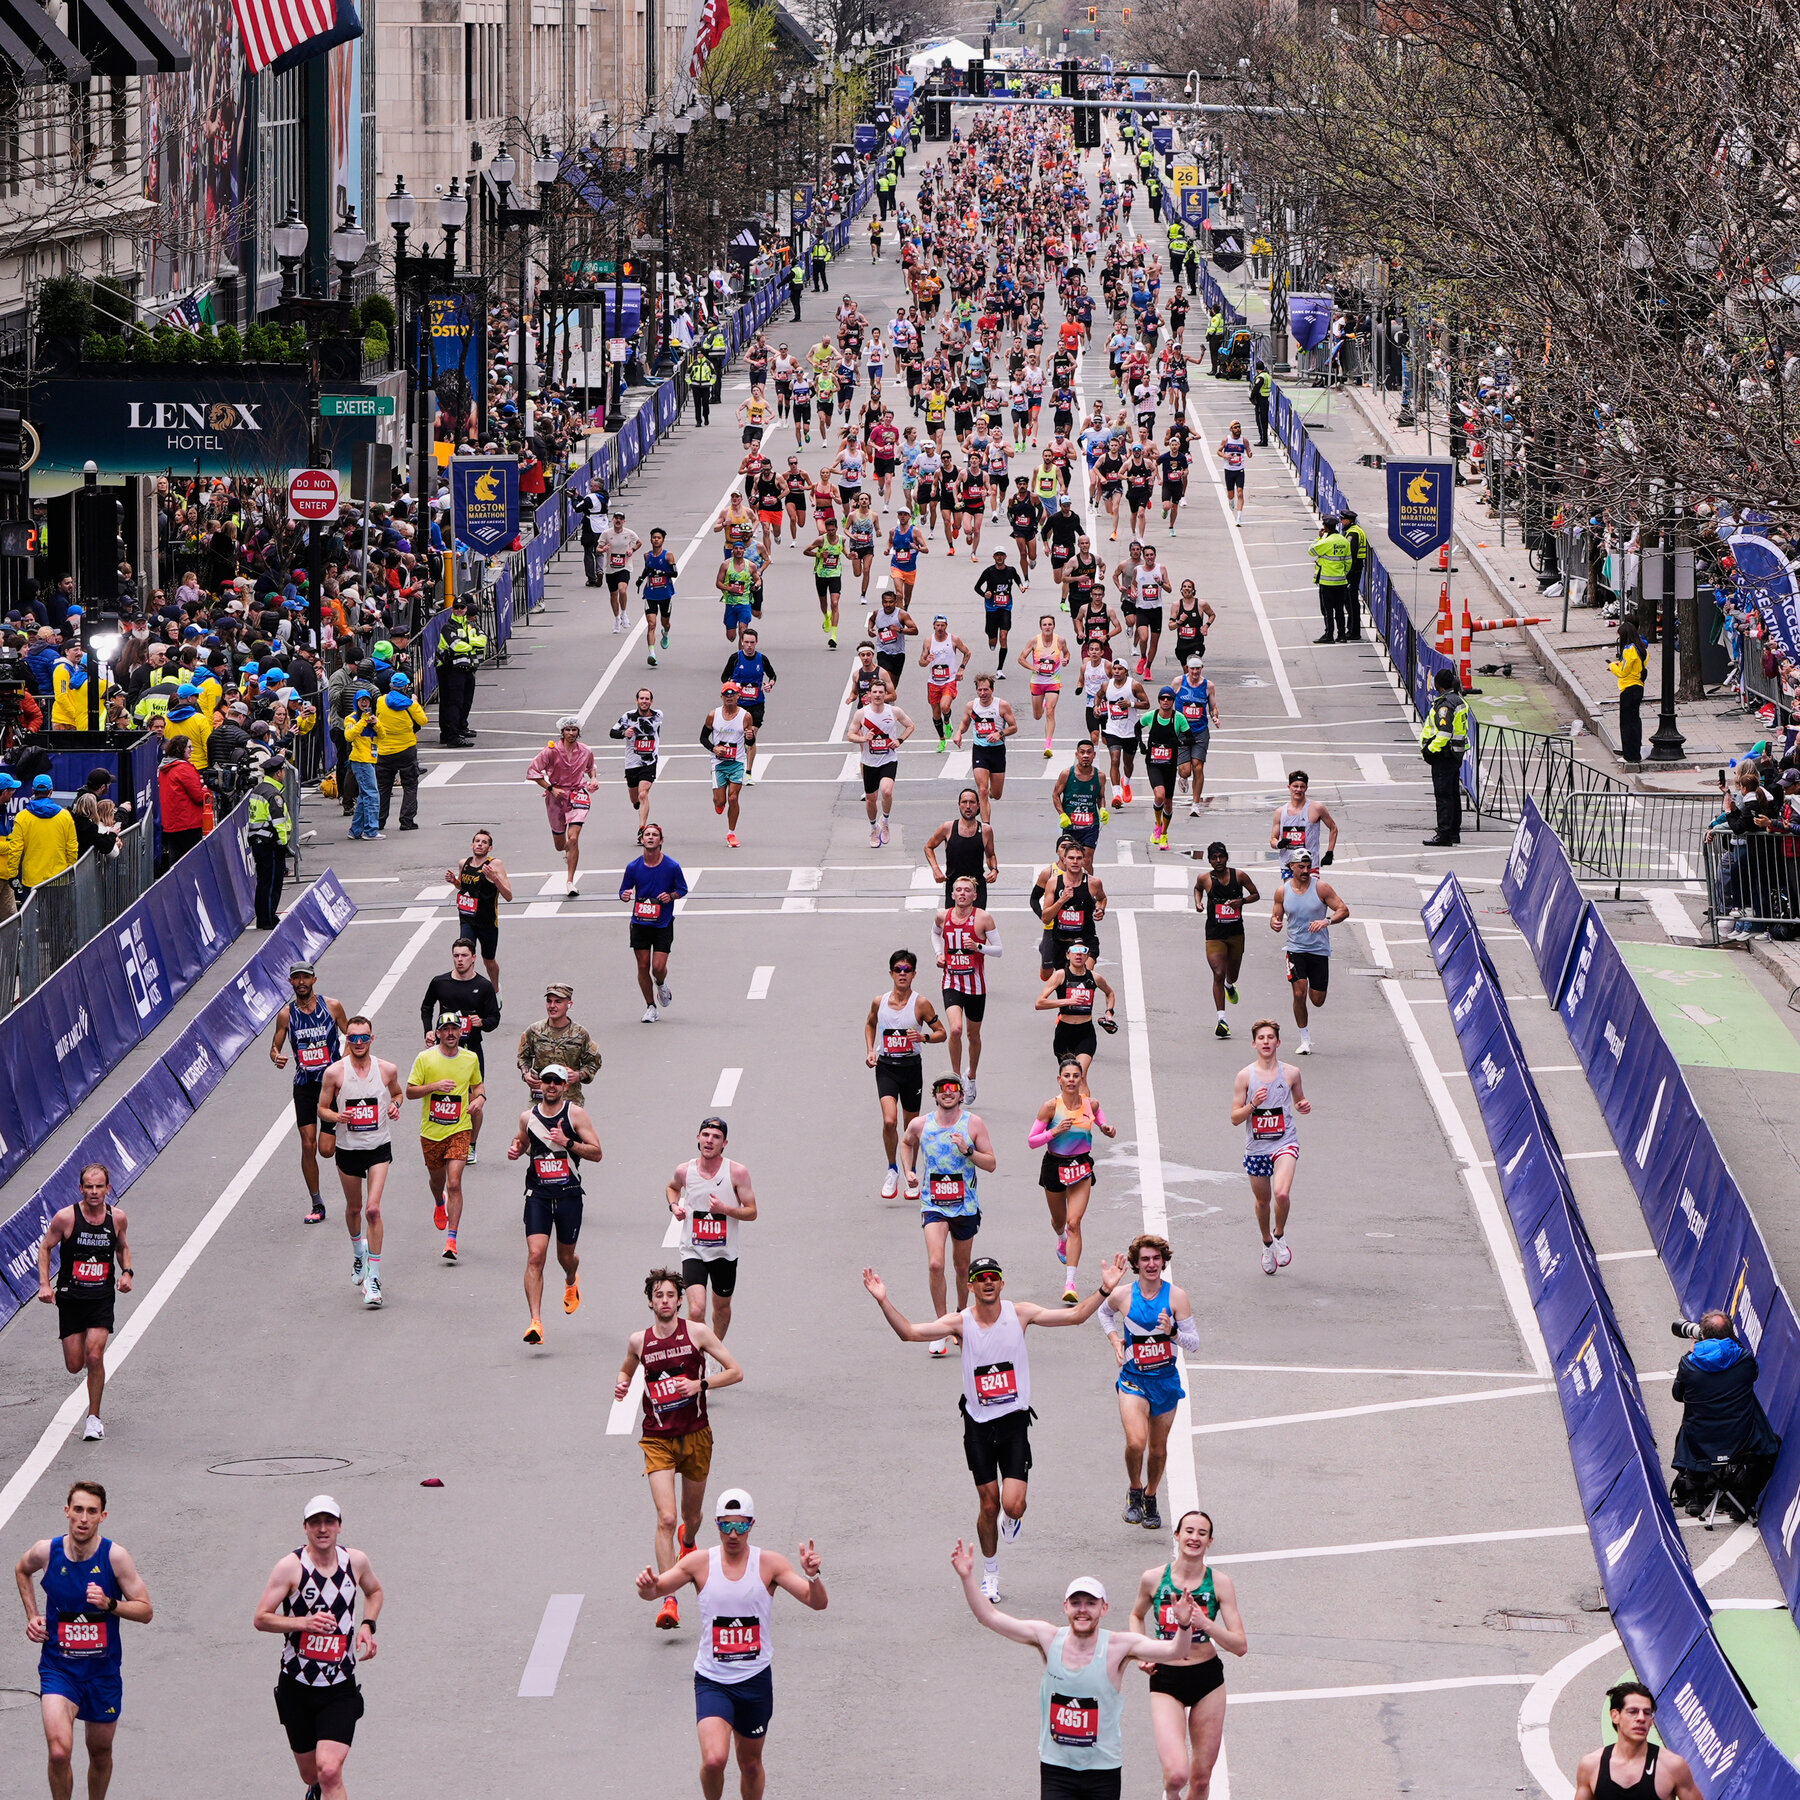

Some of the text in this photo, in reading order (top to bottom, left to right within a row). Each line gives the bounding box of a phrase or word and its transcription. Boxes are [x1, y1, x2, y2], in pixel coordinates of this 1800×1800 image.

[1177, 171, 1193, 181] 26
[432, 325, 475, 337] OSTO
[336, 400, 385, 415] EXETER ST
[127, 402, 264, 431] LENOX
[167, 436, 223, 450] HOTEL
[296, 480, 331, 489] DO NOT
[299, 501, 328, 511] ENTER
[468, 503, 505, 512] BOSTON
[1401, 505, 1437, 515] BOSTON
[1401, 514, 1437, 522] MARATHON
[26, 529, 37, 551] 2
[1754, 588, 1790, 652] SEATING
[1073, 813, 1090, 822] 7718
[950, 954, 970, 965] 2165
[434, 1102, 457, 1114] 3422
[1257, 1116, 1279, 1129] 2707
[540, 1160, 563, 1173] 5062
[935, 1181, 959, 1195] 3968
[698, 1220, 721, 1234] 1410
[77, 1237, 110, 1247] HARRIERS
[644, 1345, 693, 1364] BOSTON COLLEGE
[1138, 1343, 1166, 1358] 2504
[654, 1379, 677, 1397] 115
[981, 1373, 1009, 1391] 5241
[304, 1587, 316, 1600] S
[65, 1624, 98, 1642] 5333
[719, 1629, 754, 1645] 6114
[306, 1634, 340, 1654] 2074
[1056, 1707, 1089, 1729] 4351
[1673, 1681, 1701, 1724] BANK
[1691, 1716, 1724, 1769] AMERICA
